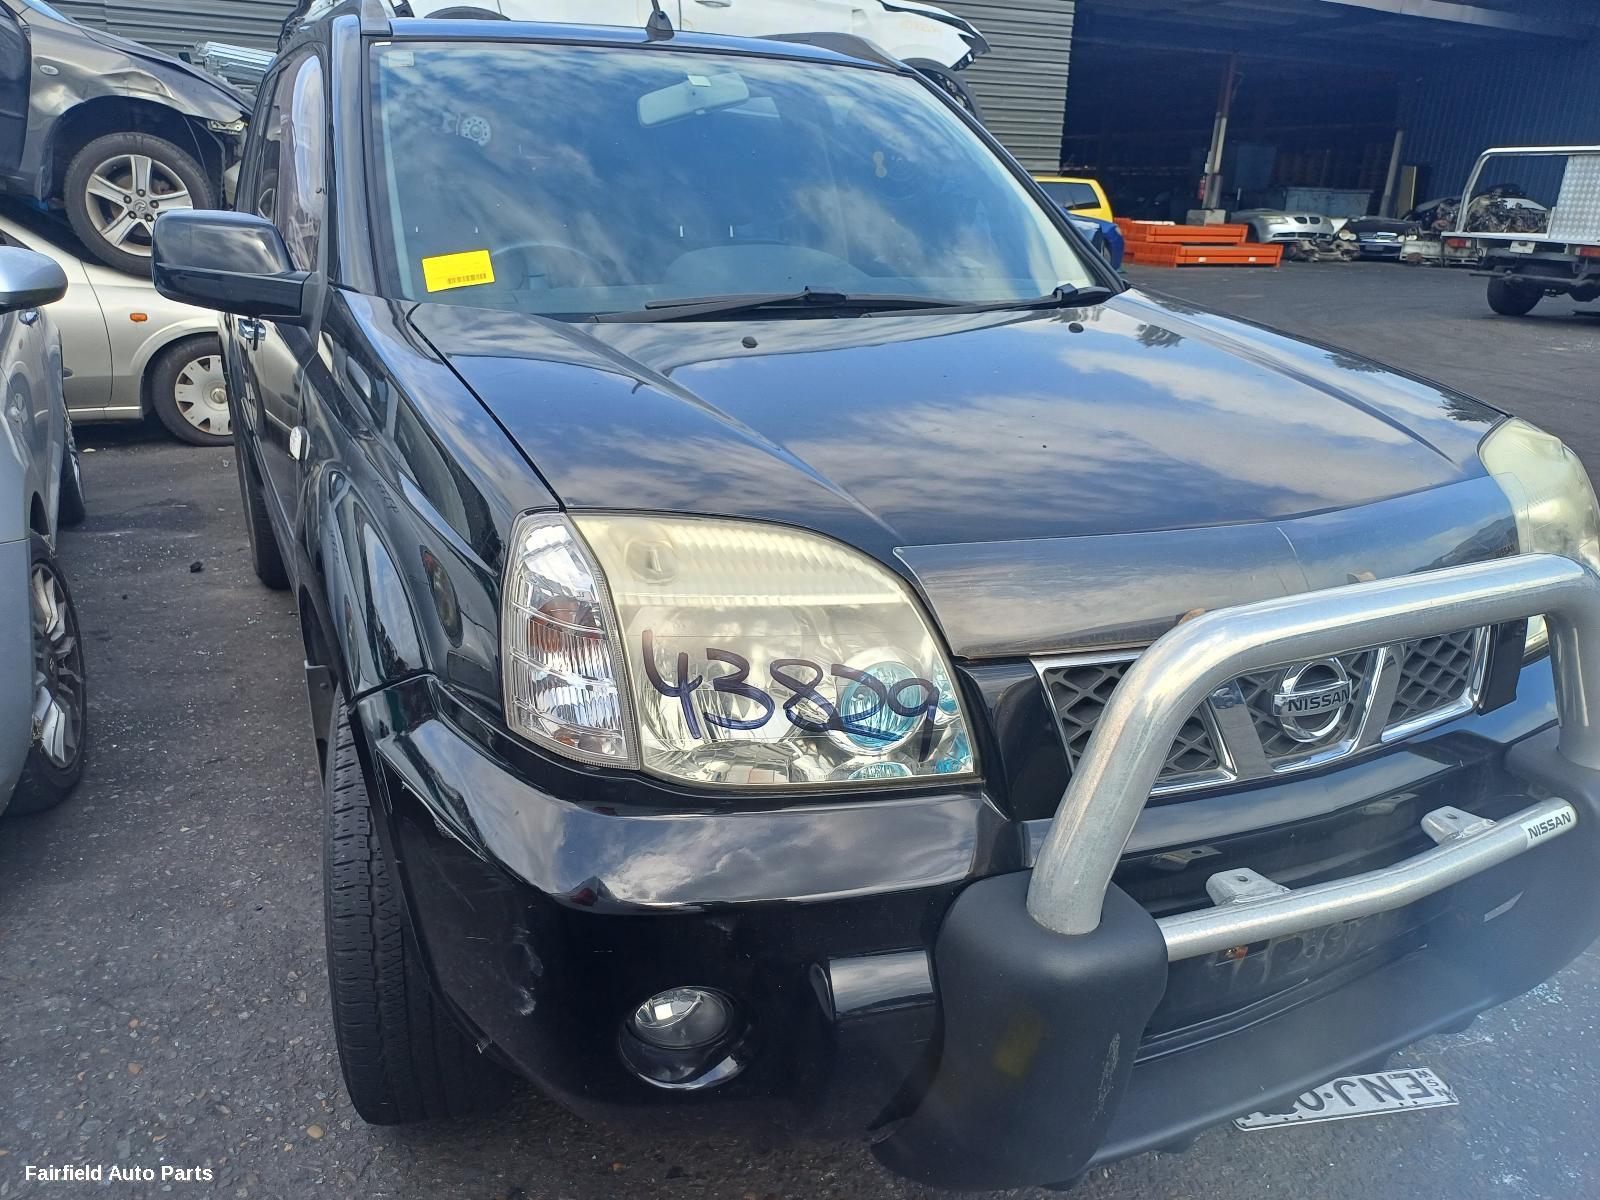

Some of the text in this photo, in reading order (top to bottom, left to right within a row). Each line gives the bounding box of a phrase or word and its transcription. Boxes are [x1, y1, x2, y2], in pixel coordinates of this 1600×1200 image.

[641, 629, 940, 762] 43829
[1287, 689, 1350, 712] NISSAN
[1527, 811, 1572, 840] NISSAN
